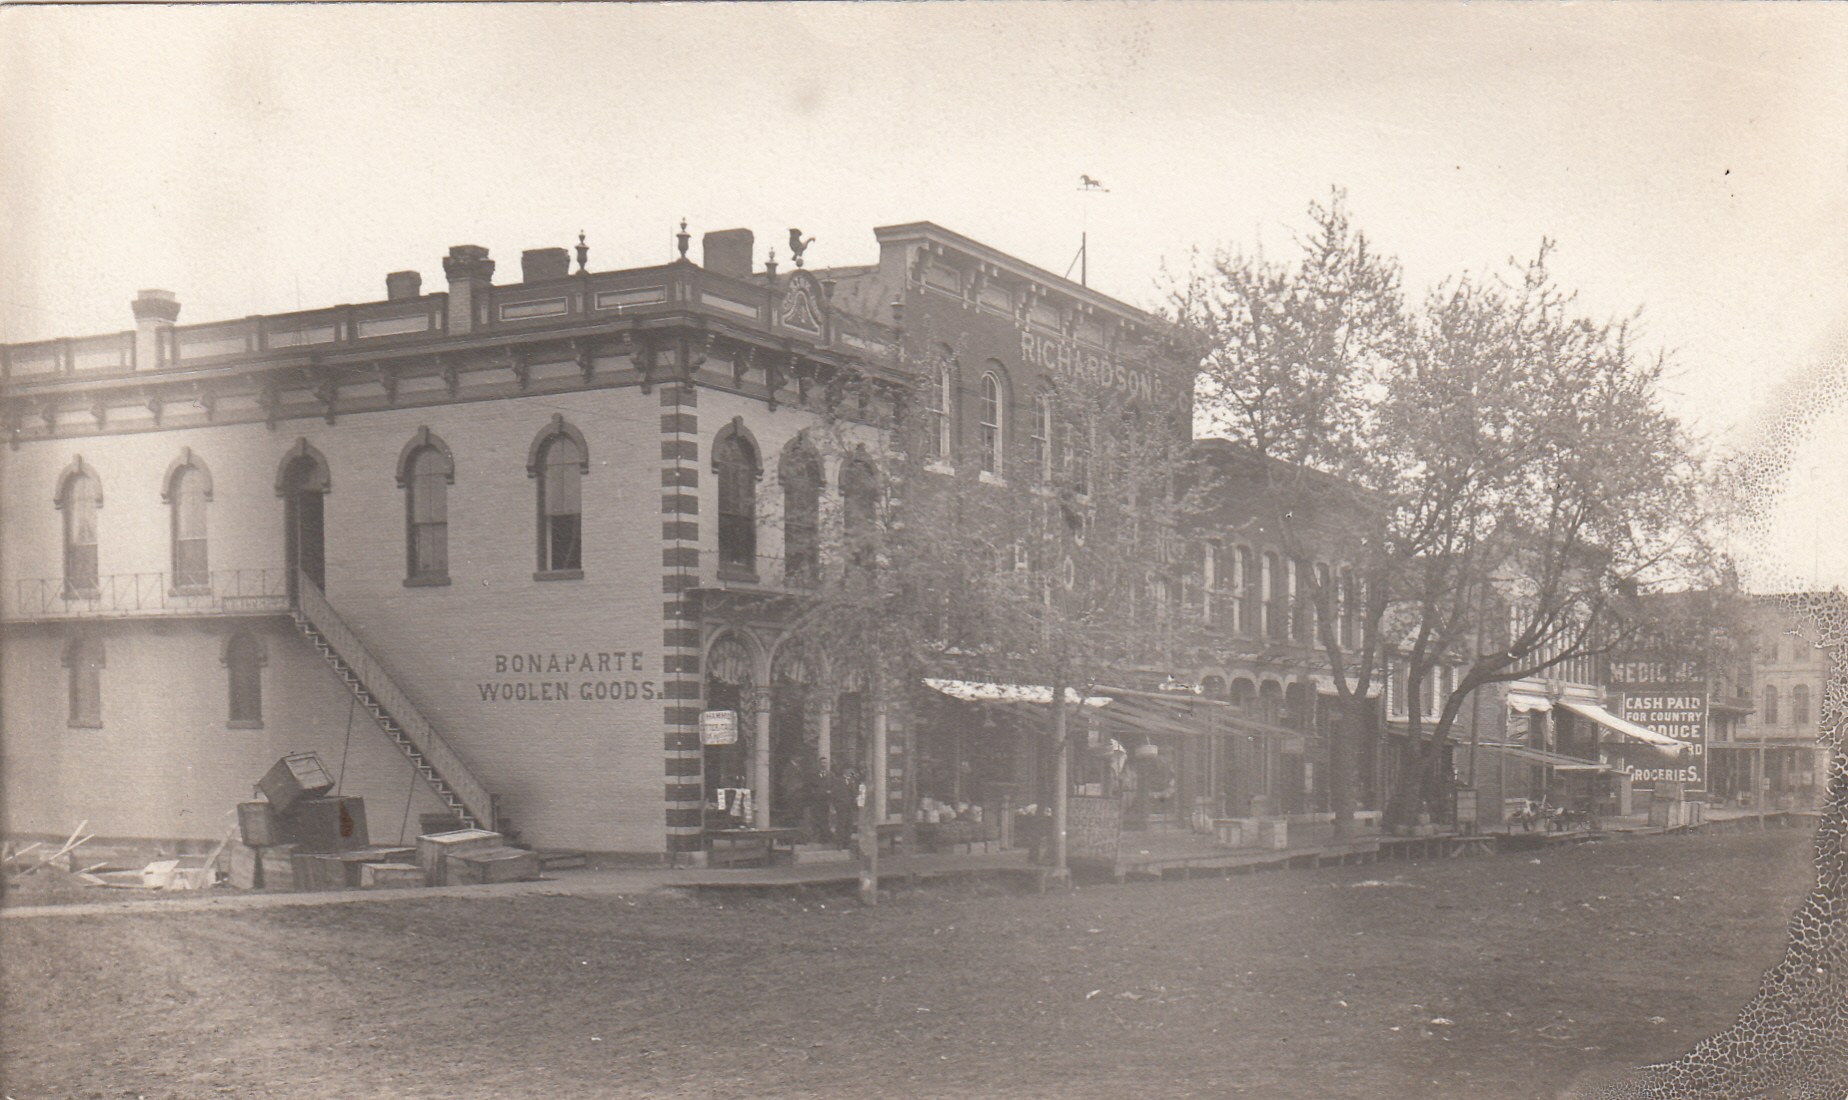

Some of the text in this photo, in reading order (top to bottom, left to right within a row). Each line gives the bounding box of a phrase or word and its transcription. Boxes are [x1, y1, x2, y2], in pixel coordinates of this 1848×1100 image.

[1020, 330, 1152, 402] RICHARDSON
[495, 651, 643, 673] BONAPARTE
[478, 680, 664, 701] WOOLEN GOODS.
[1625, 697, 1701, 710] CASH PAID
[1626, 711, 1703, 722] FOR COUNTRY
